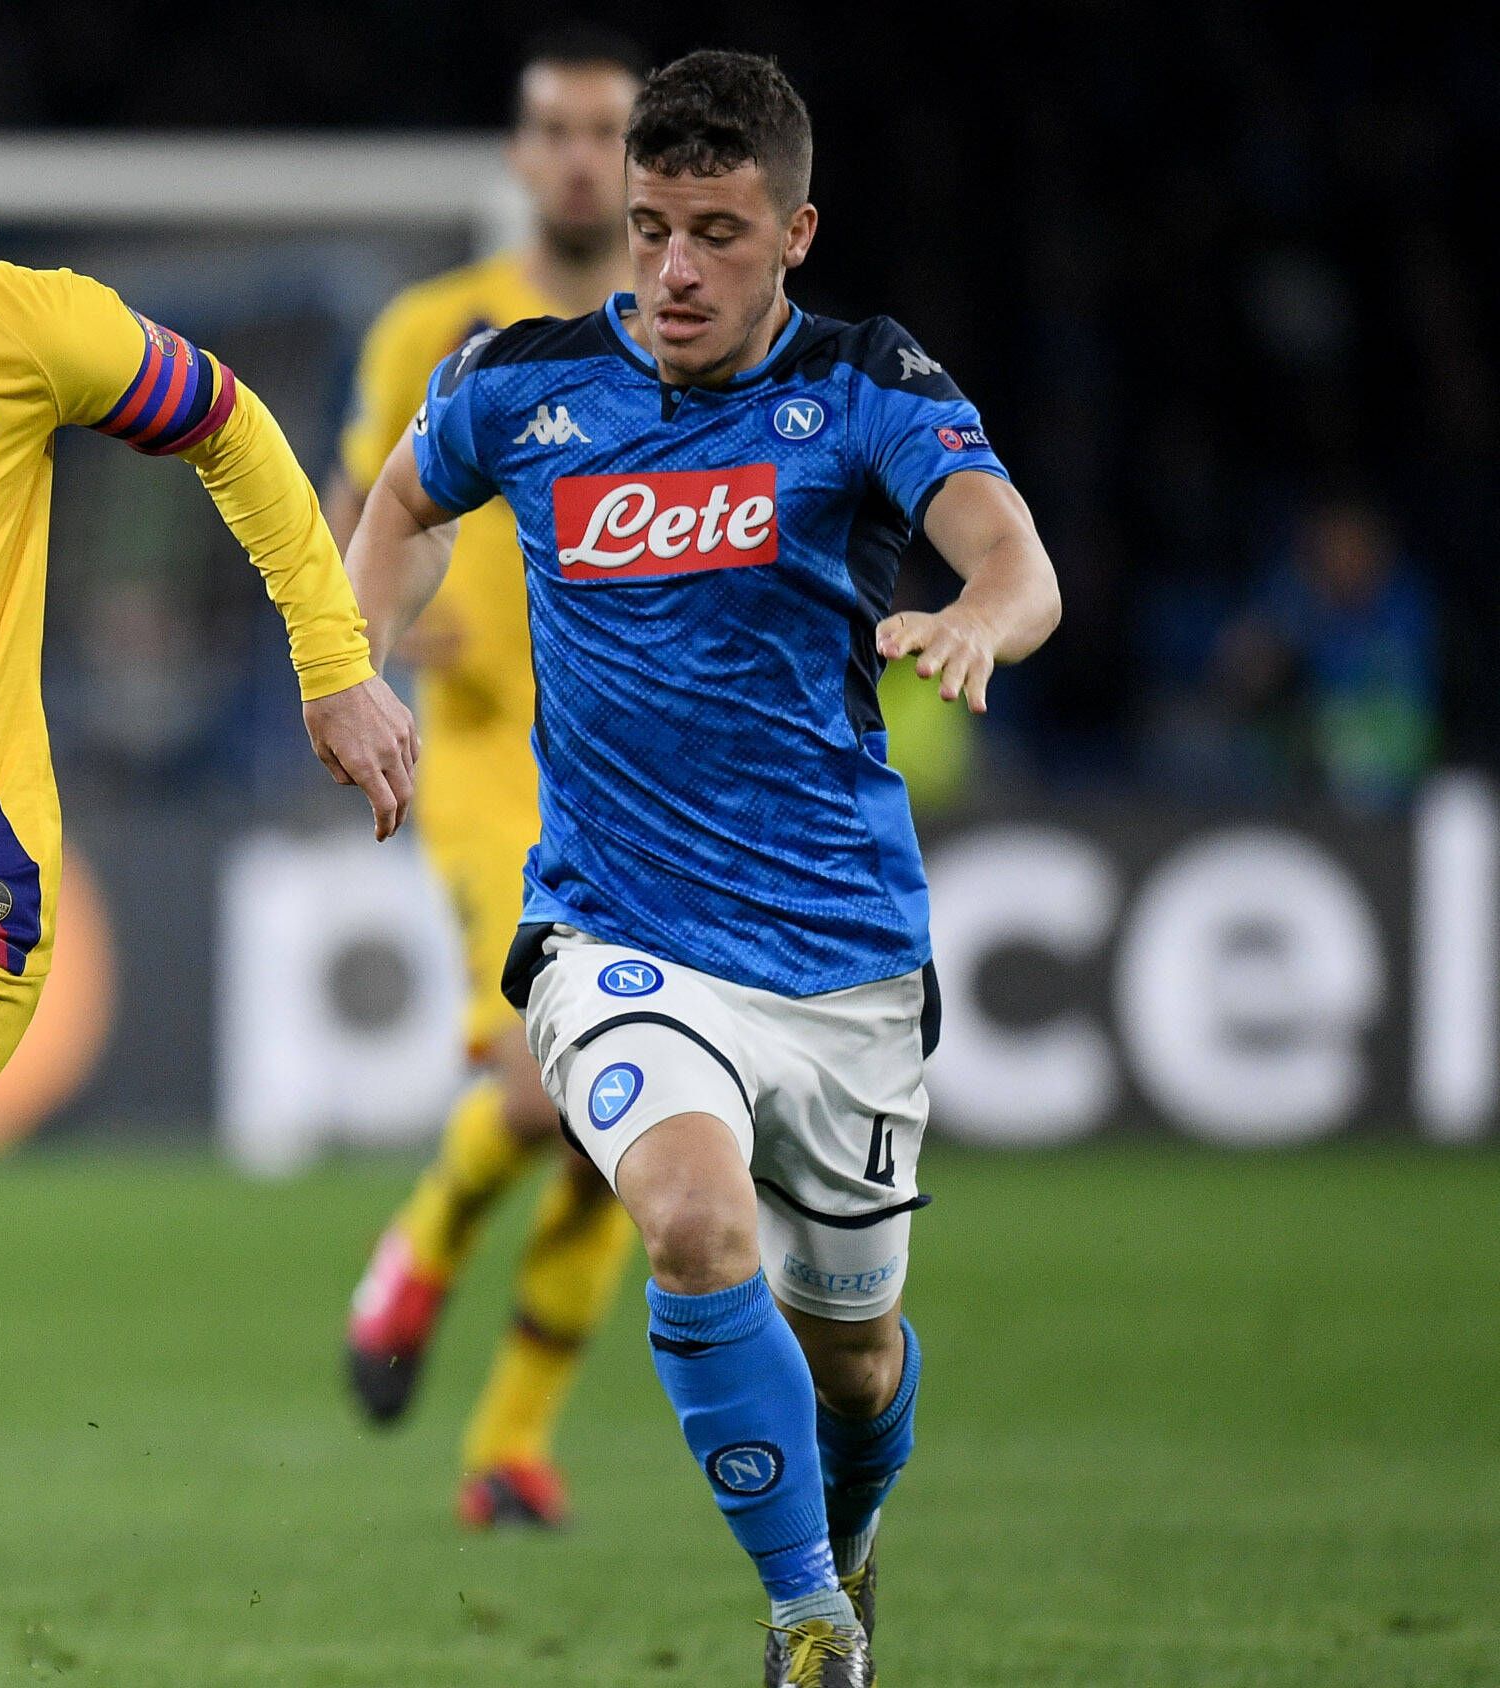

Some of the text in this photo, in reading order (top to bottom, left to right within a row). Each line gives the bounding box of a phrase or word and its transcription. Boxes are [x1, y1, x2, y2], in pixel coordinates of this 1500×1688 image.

[783, 406, 815, 432] N
[558, 482, 774, 568] Lete
[212, 770, 1500, 1180] pcel
[615, 968, 645, 989] N
[597, 1074, 626, 1115] N
[863, 1113, 896, 1188] 4
[725, 1454, 762, 1485] N
